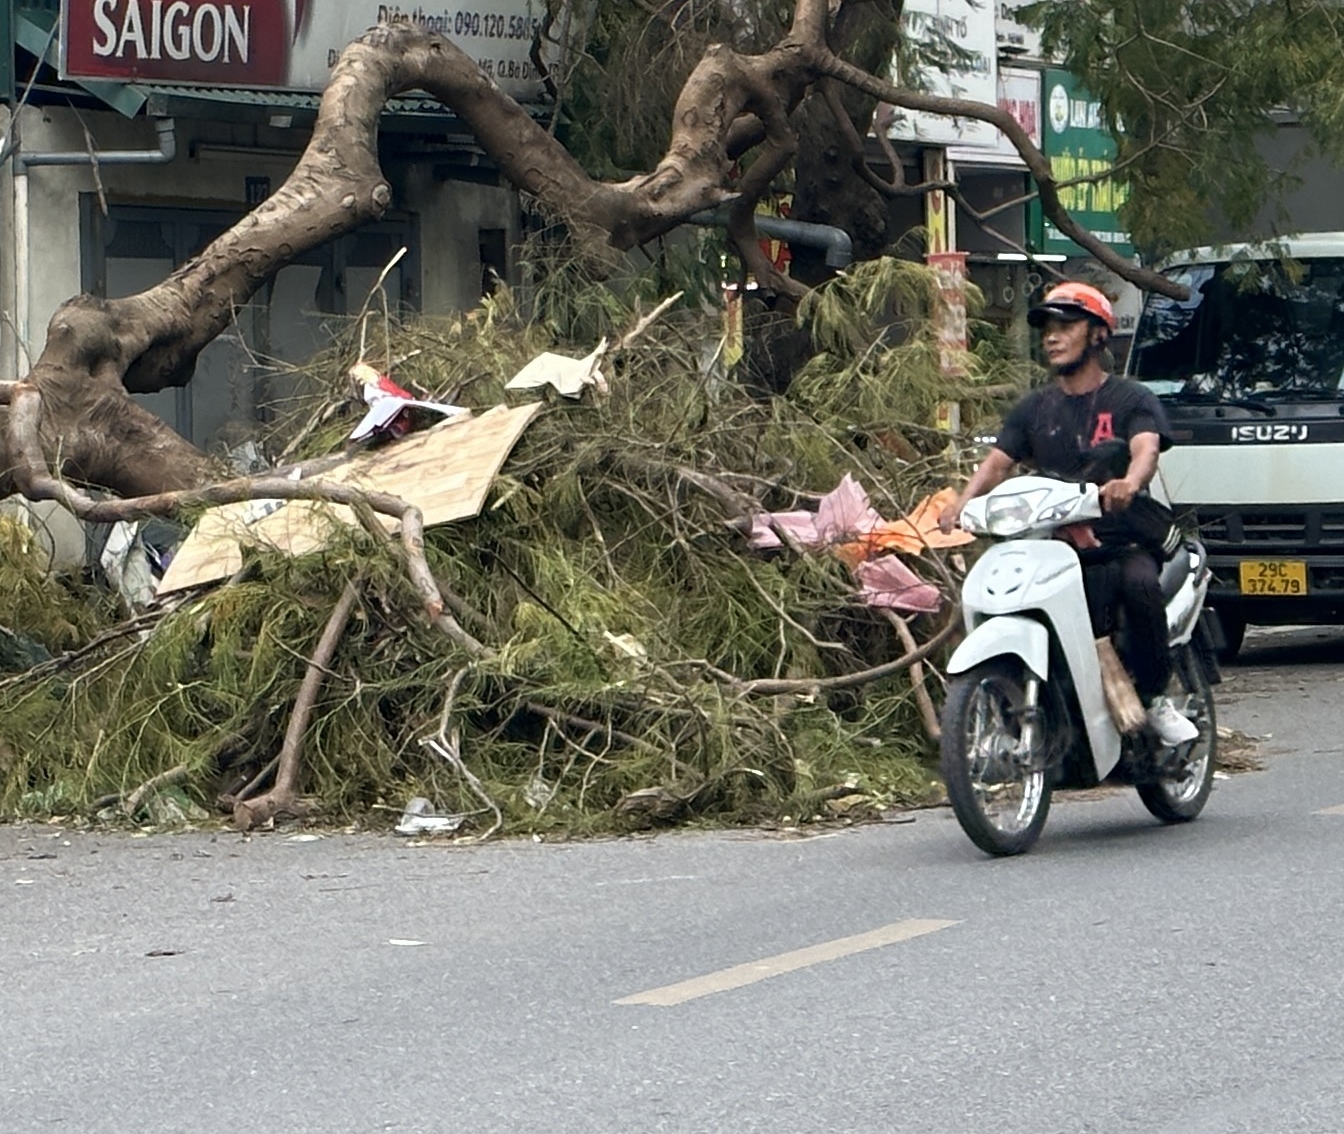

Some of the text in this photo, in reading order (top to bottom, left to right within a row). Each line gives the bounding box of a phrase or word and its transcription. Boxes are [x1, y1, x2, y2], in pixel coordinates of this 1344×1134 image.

[1090, 412, 1116, 447] A
[1231, 424, 1308, 442] ISUZU
[1258, 562, 1288, 578] 29C
[1247, 578, 1301, 595] 374.79
